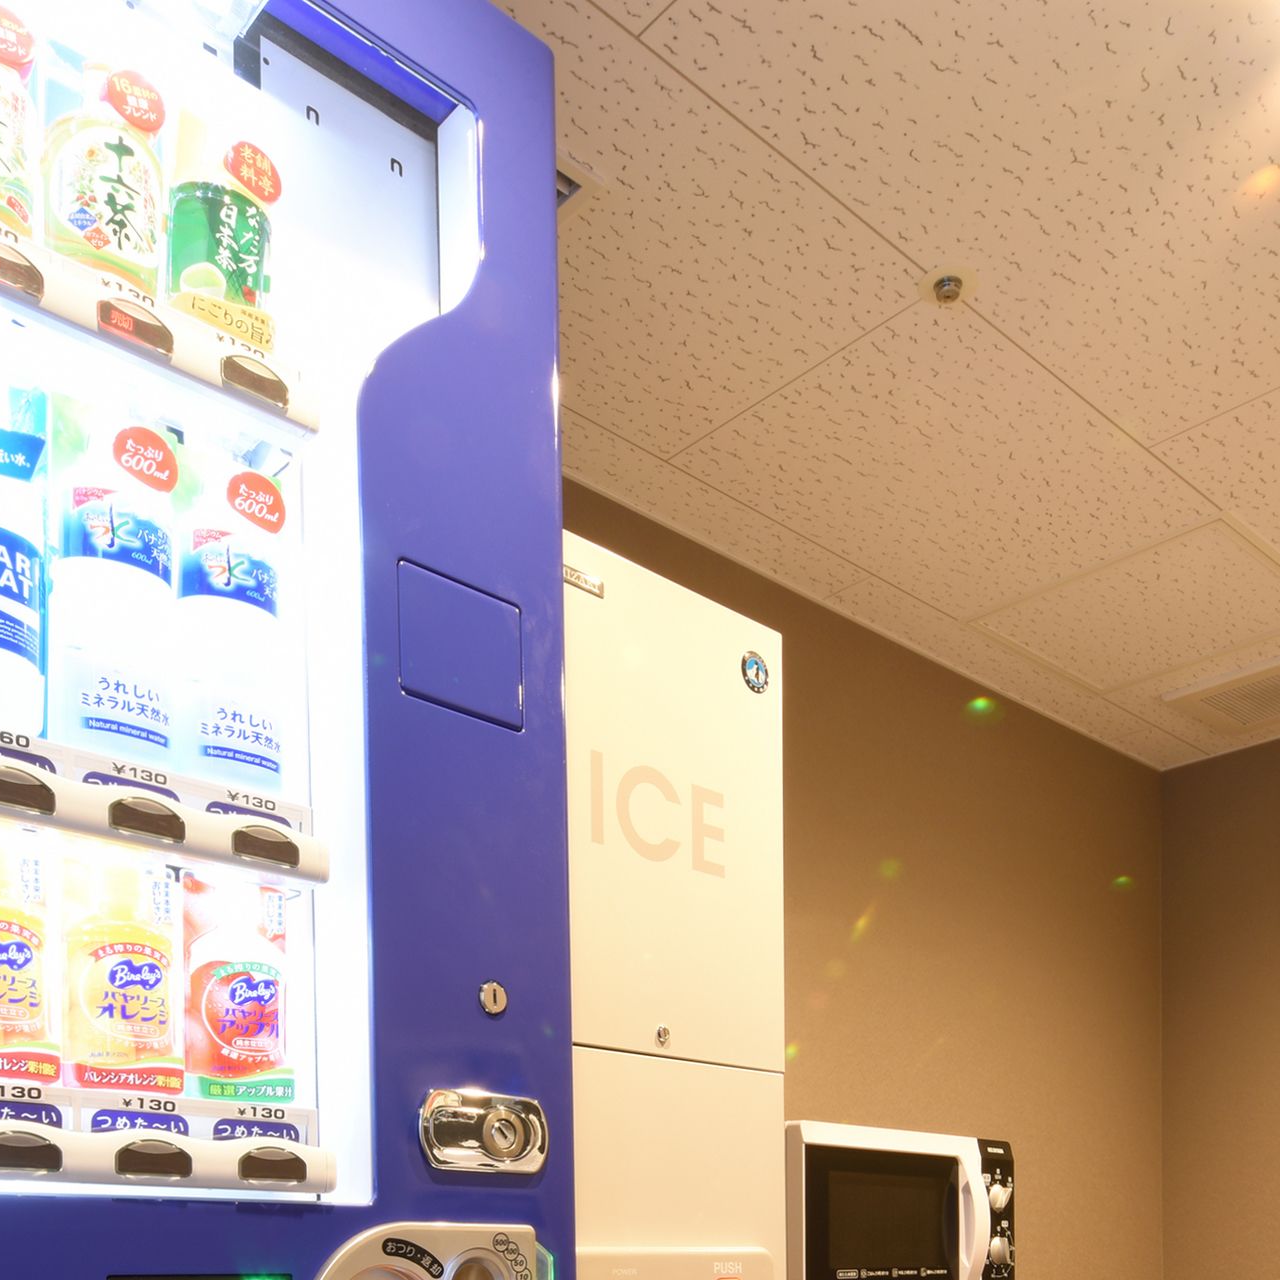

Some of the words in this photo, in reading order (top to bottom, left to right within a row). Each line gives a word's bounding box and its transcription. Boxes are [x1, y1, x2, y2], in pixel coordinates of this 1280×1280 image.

[99, 135, 144, 250] 十六茶
[125, 438, 163, 462] たっぷり
[120, 454, 169, 481] 600ml
[239, 483, 274, 505] たっぷり
[234, 496, 280, 523] 600ml
[97, 676, 160, 702] うれしい
[80, 691, 170, 727] ミネラル天然水
[216, 706, 273, 731] うれしい
[88, 718, 118, 733] Natural
[119, 724, 147, 739] mineral
[147, 731, 167, 745] water
[200, 721, 281, 754] ミネラル天然水
[235, 750, 261, 764] mineral
[111, 761, 168, 786] ¥130
[226, 789, 277, 812] ¥130
[590, 749, 726, 879] ICE
[102, 990, 166, 1008] バヤリース
[208, 1084, 294, 1099] 厳選アップル果汁
[121, 1097, 177, 1113] ¥130
[237, 1107, 286, 1120] ¥130
[385, 1240, 443, 1278] おつり・返却
[713, 1262, 743, 1274] PUSH
